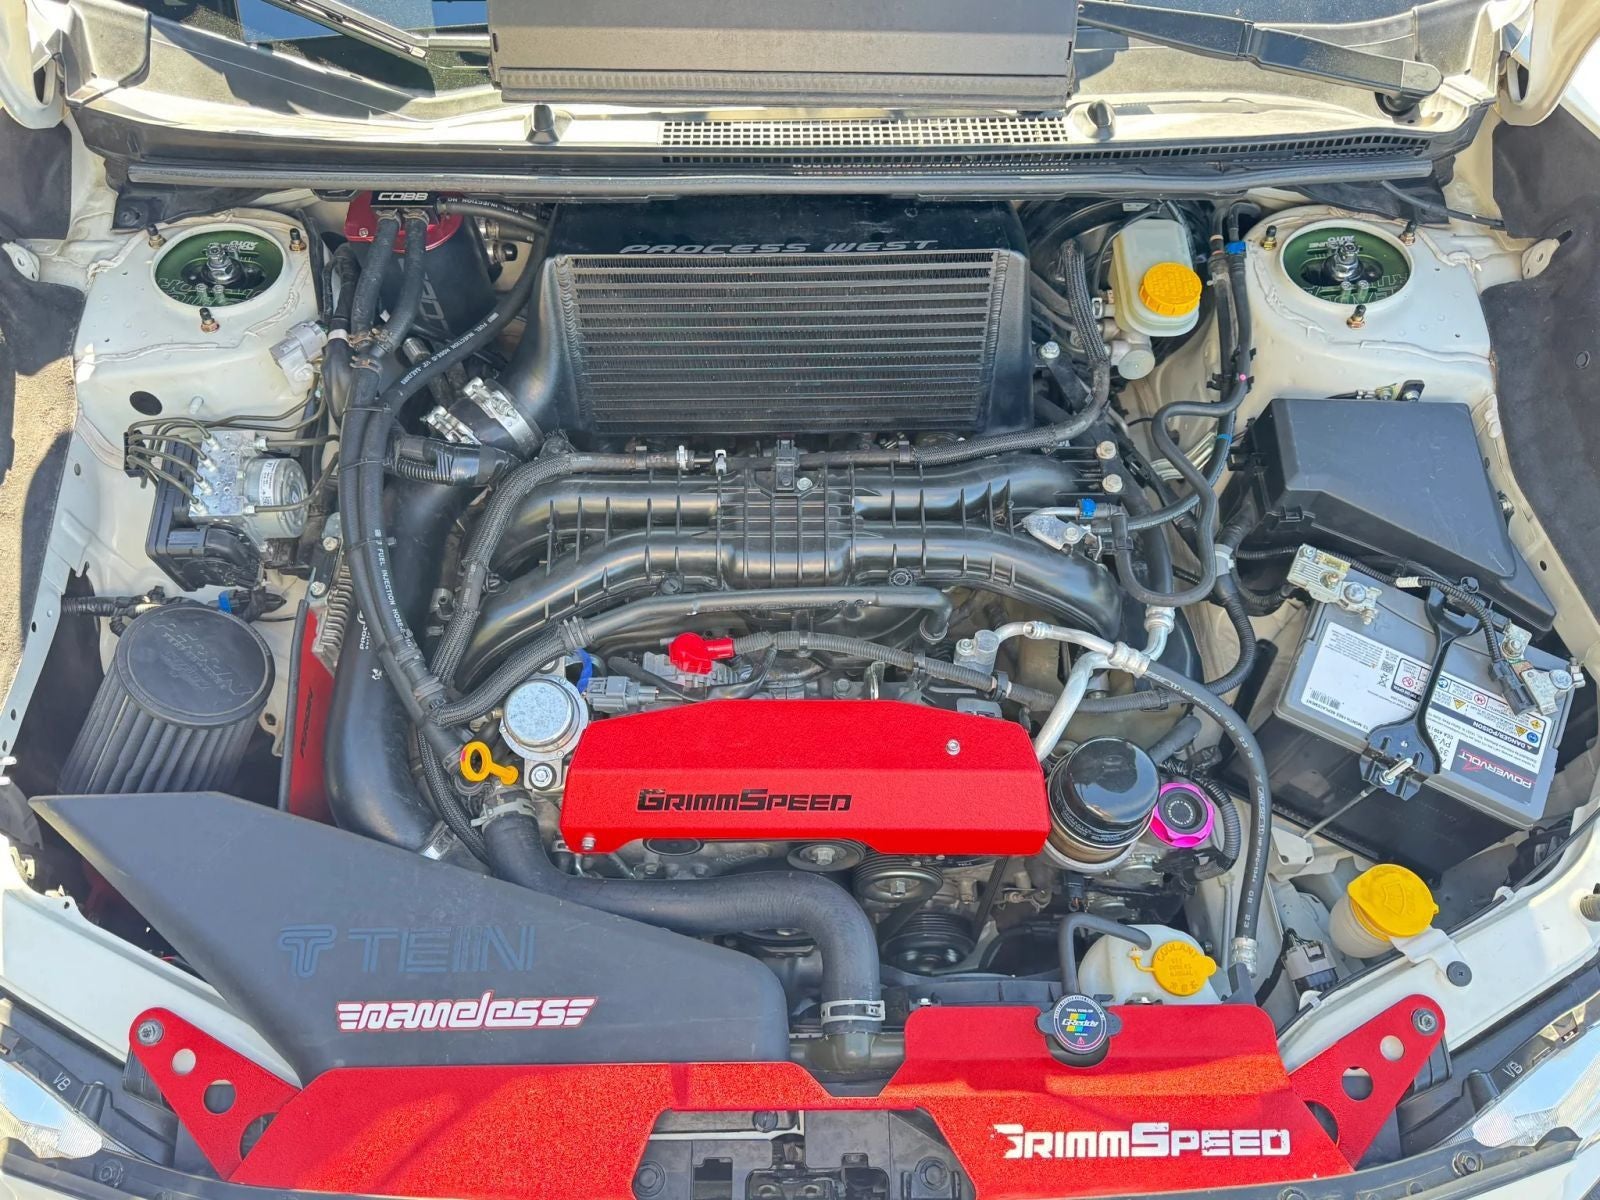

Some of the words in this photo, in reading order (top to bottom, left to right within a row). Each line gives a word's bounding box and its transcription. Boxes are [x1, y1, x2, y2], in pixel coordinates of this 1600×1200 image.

[378, 192, 429, 201] COBB
[461, 198, 499, 208] INJECTION
[503, 206, 519, 214] FUEL
[619, 243, 811, 254] PROCESS
[823, 239, 939, 252] WEST
[474, 322, 488, 333] FUEL
[450, 332, 475, 350] INJECTION
[377, 548, 386, 566] FUEL
[381, 569, 396, 605] INJECTION
[1305, 697, 1336, 715] REPLACEMENT
[1335, 711, 1347, 720] FREE
[1345, 715, 1362, 727] MONTH
[1429, 732, 1452, 748] PV-3
[1472, 721, 1526, 748] DANGER/POISON
[1457, 751, 1532, 789] POWERVOLT
[636, 788, 853, 812] GRIMMSPEED
[349, 925, 536, 973] TEIN
[1157, 944, 1199, 962] COOLANT
[337, 989, 598, 1033] nameless
